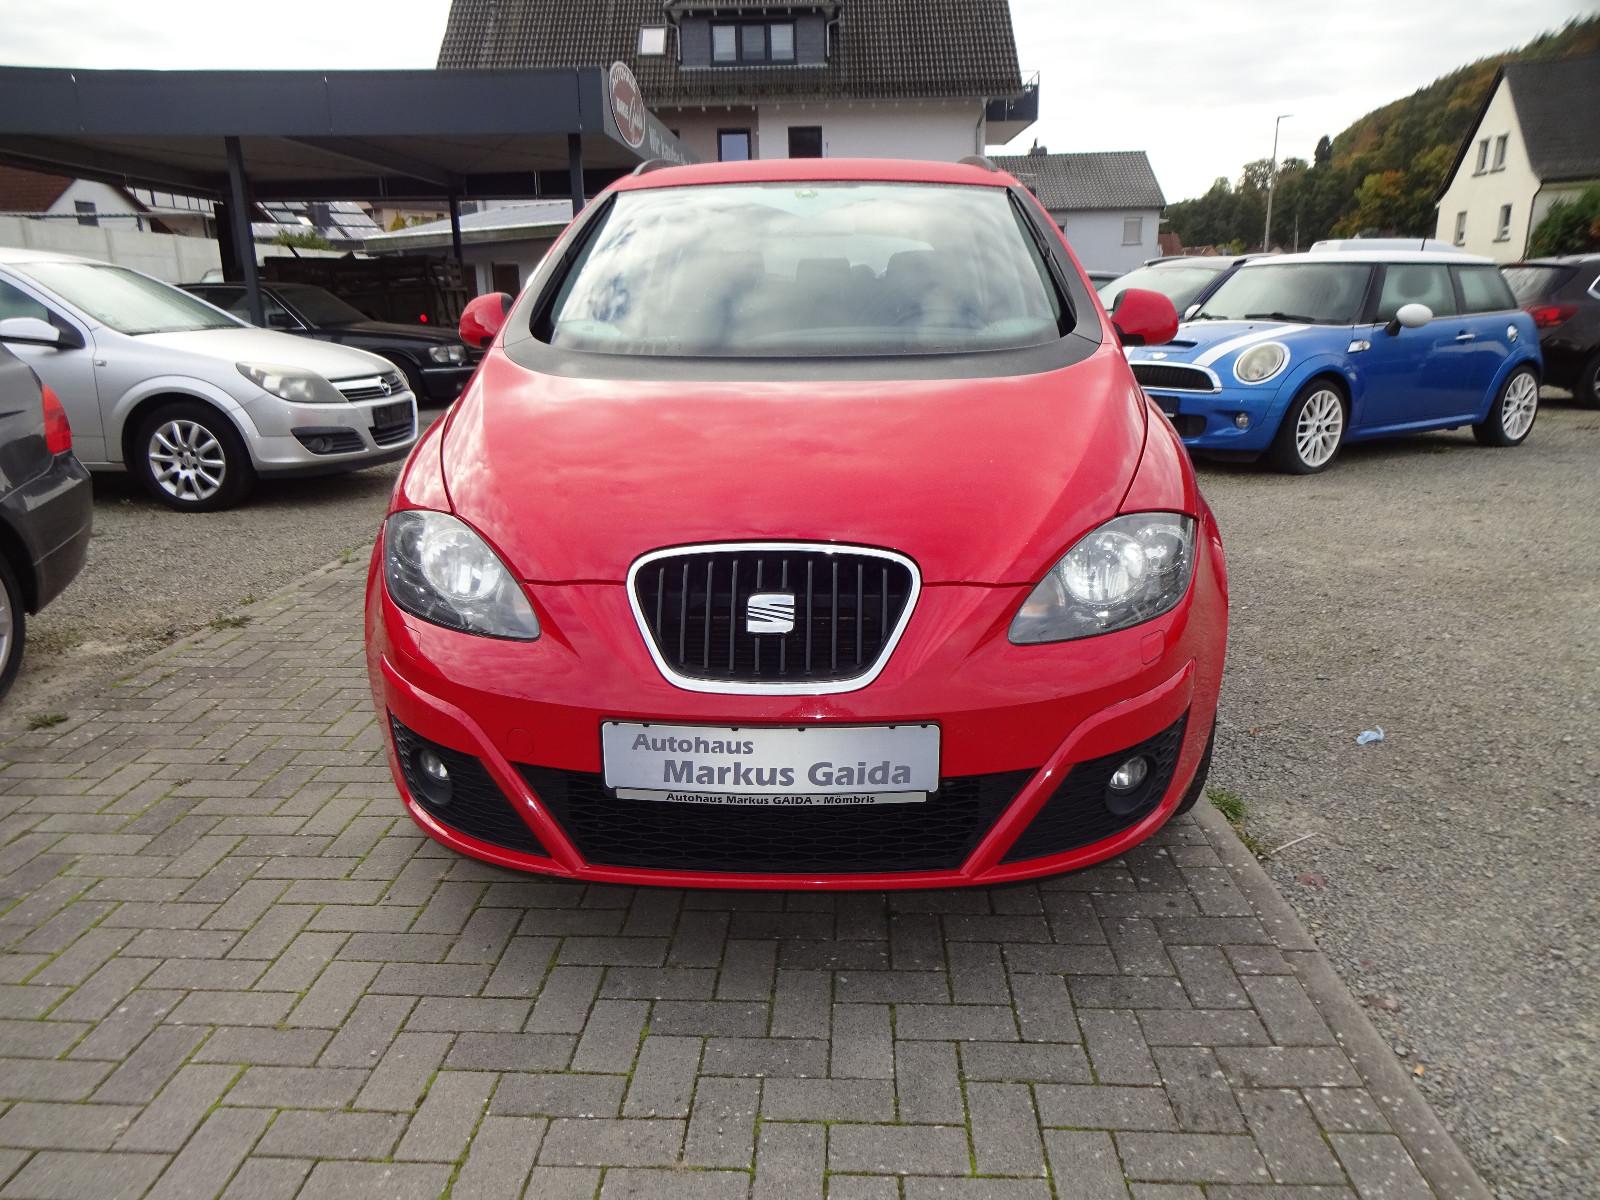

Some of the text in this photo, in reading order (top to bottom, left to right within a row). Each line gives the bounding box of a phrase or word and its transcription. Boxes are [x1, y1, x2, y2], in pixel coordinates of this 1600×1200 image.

[632, 733, 754, 755] Autohaus
[663, 759, 912, 787] Markus Gaida
[665, 792, 876, 805] Autohaus Markus GAIDA Mömbris
